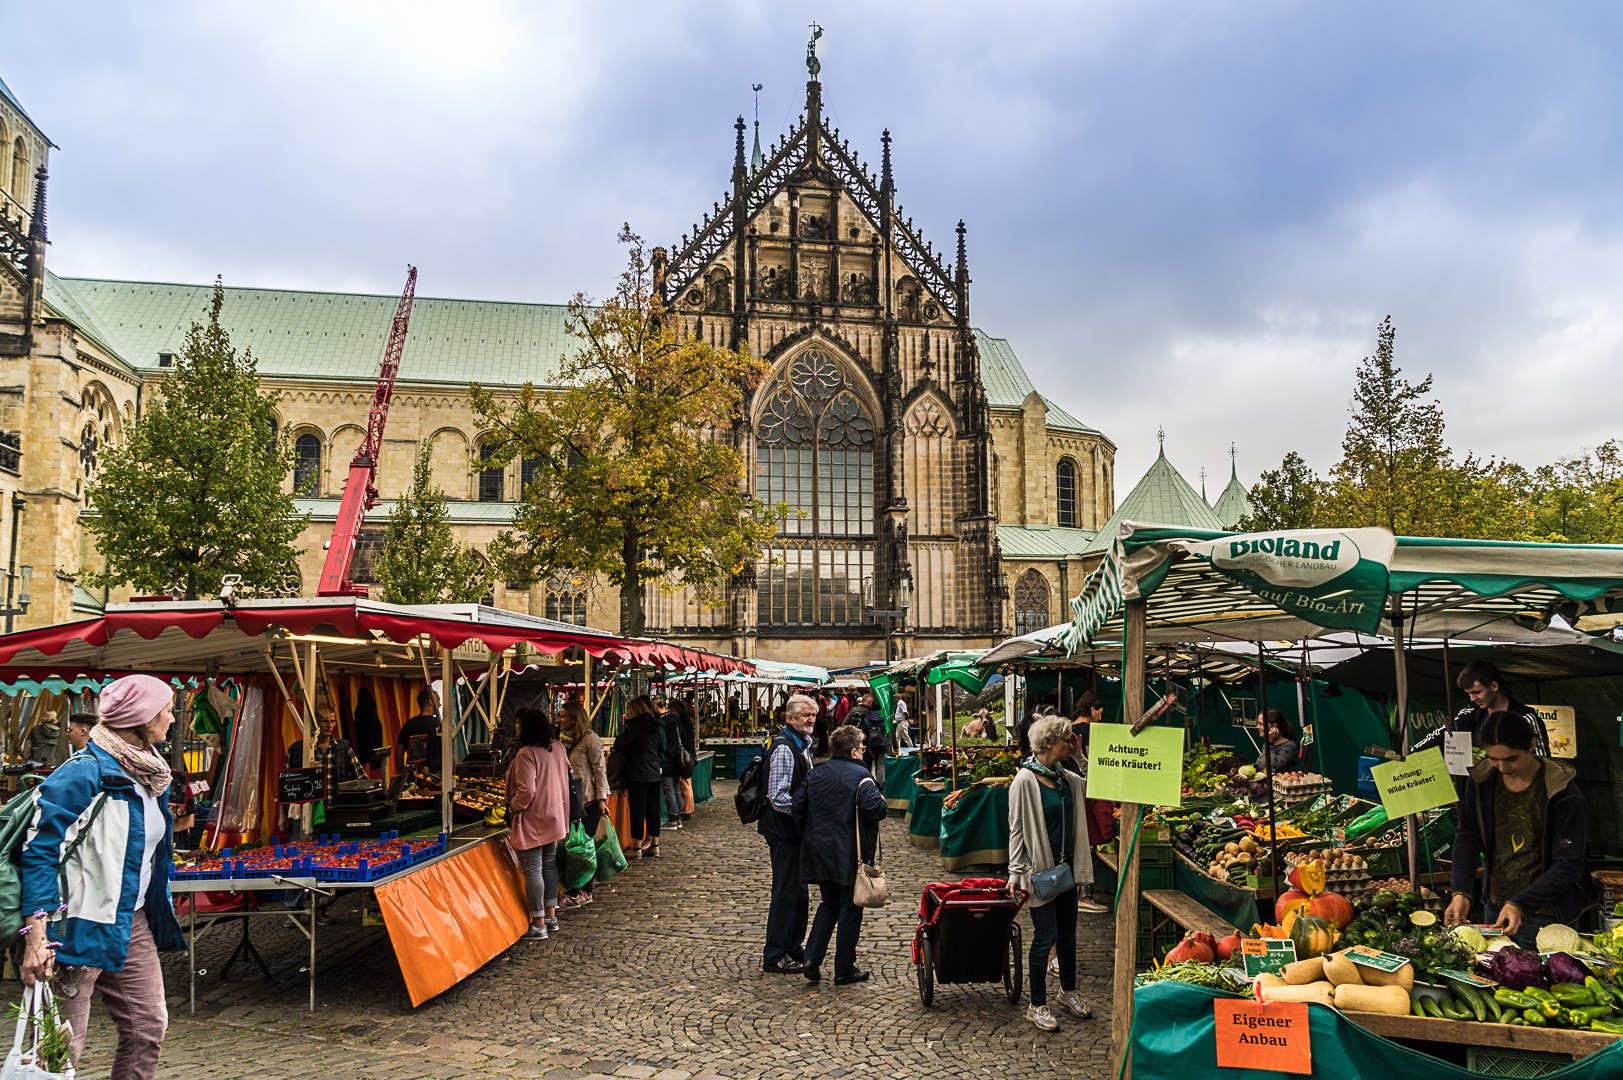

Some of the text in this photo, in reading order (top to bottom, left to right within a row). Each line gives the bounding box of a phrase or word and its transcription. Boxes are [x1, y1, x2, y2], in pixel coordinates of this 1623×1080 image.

[1230, 537, 1341, 561] Bioland
[1295, 561, 1337, 571] LANDBAU
[1259, 587, 1294, 605] auf
[1295, 594, 1366, 615] Bio-Art
[1108, 744, 1149, 757] Achtung:
[1098, 757, 1162, 771] Wilde Kräuter!
[1392, 768, 1423, 783] Achtung:
[1386, 774, 1436, 795] Wilde Kräuter!
[1232, 1013, 1292, 1029] Eigener
[1238, 1032, 1288, 1047] Anbau
